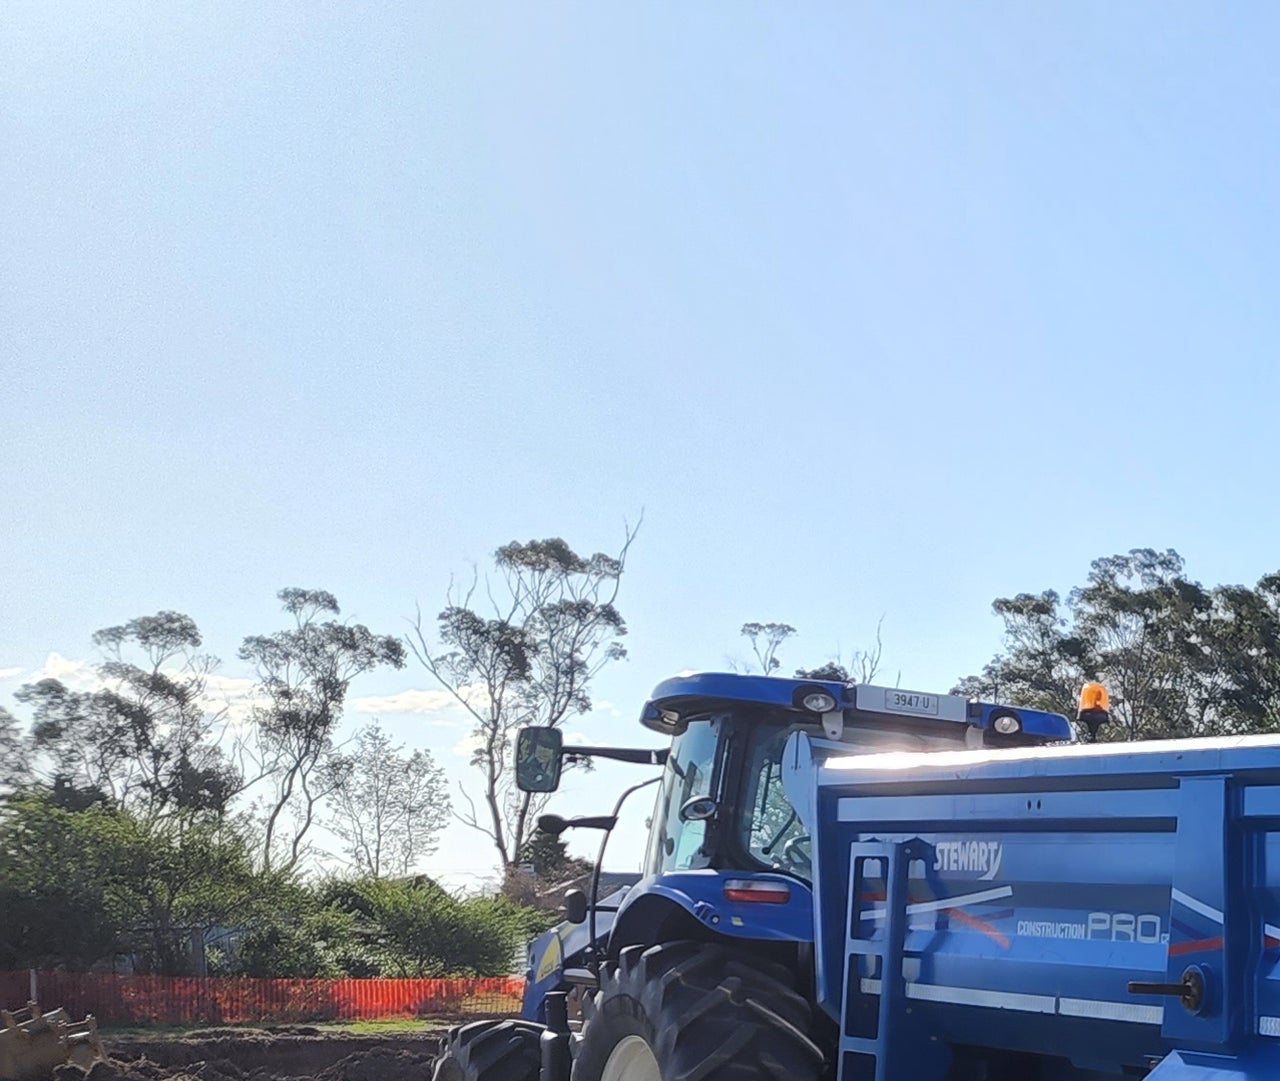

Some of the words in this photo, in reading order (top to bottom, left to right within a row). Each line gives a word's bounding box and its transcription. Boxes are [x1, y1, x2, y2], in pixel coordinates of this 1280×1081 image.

[894, 693, 920, 707] 3947
[934, 841, 1002, 881] STEWART
[1017, 920, 1085, 939] CONSTRUCTION
[1088, 912, 1161, 943] PRO
